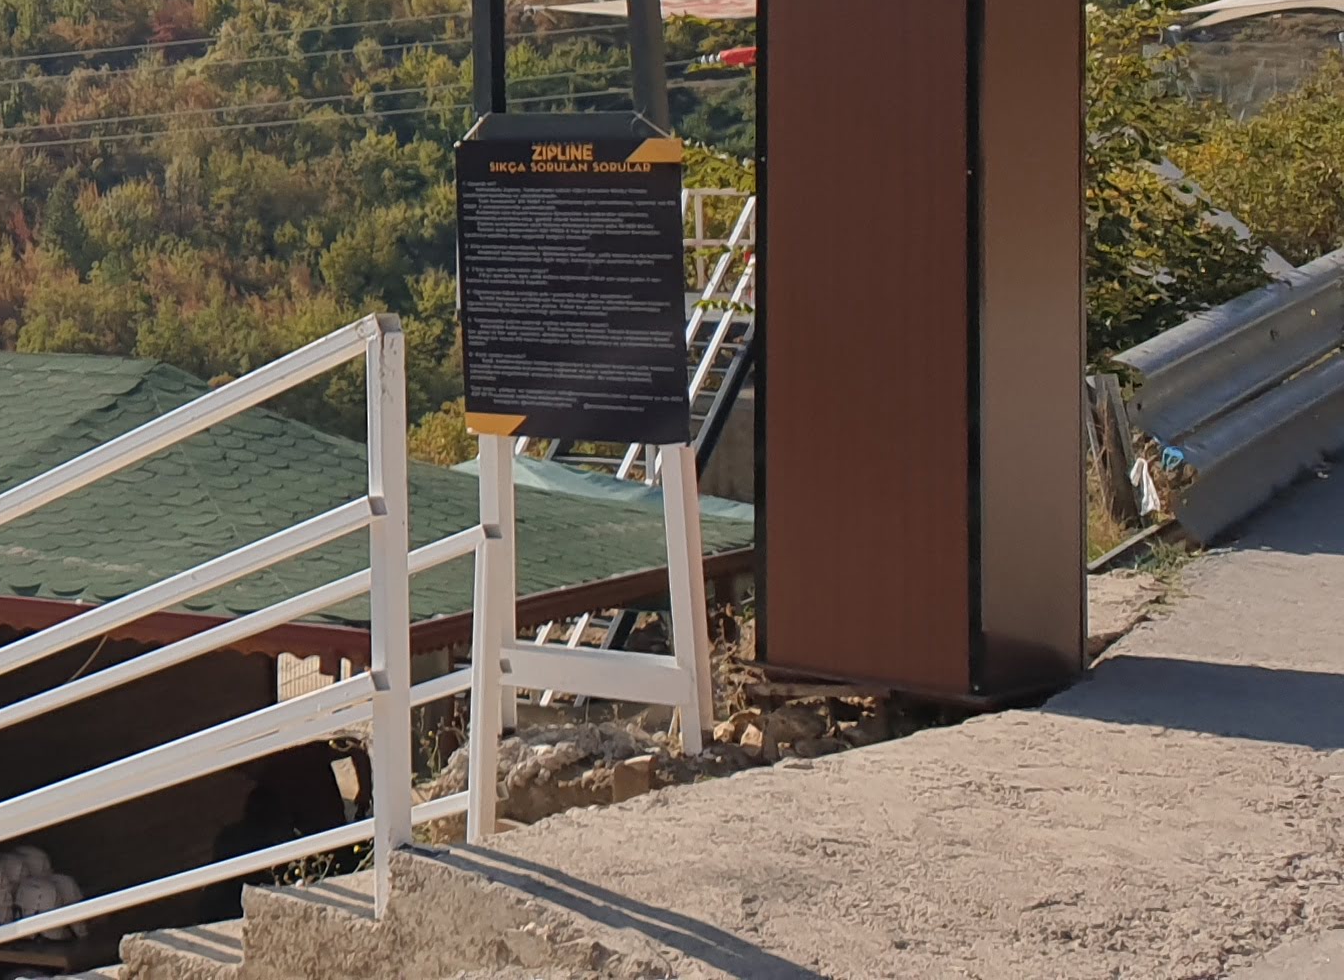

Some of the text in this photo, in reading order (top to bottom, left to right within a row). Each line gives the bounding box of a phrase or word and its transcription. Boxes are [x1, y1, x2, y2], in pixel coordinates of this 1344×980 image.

[531, 144, 594, 161] ZIPLINE
[530, 162, 588, 173] SORULAN
[592, 162, 652, 173] SORULAR
